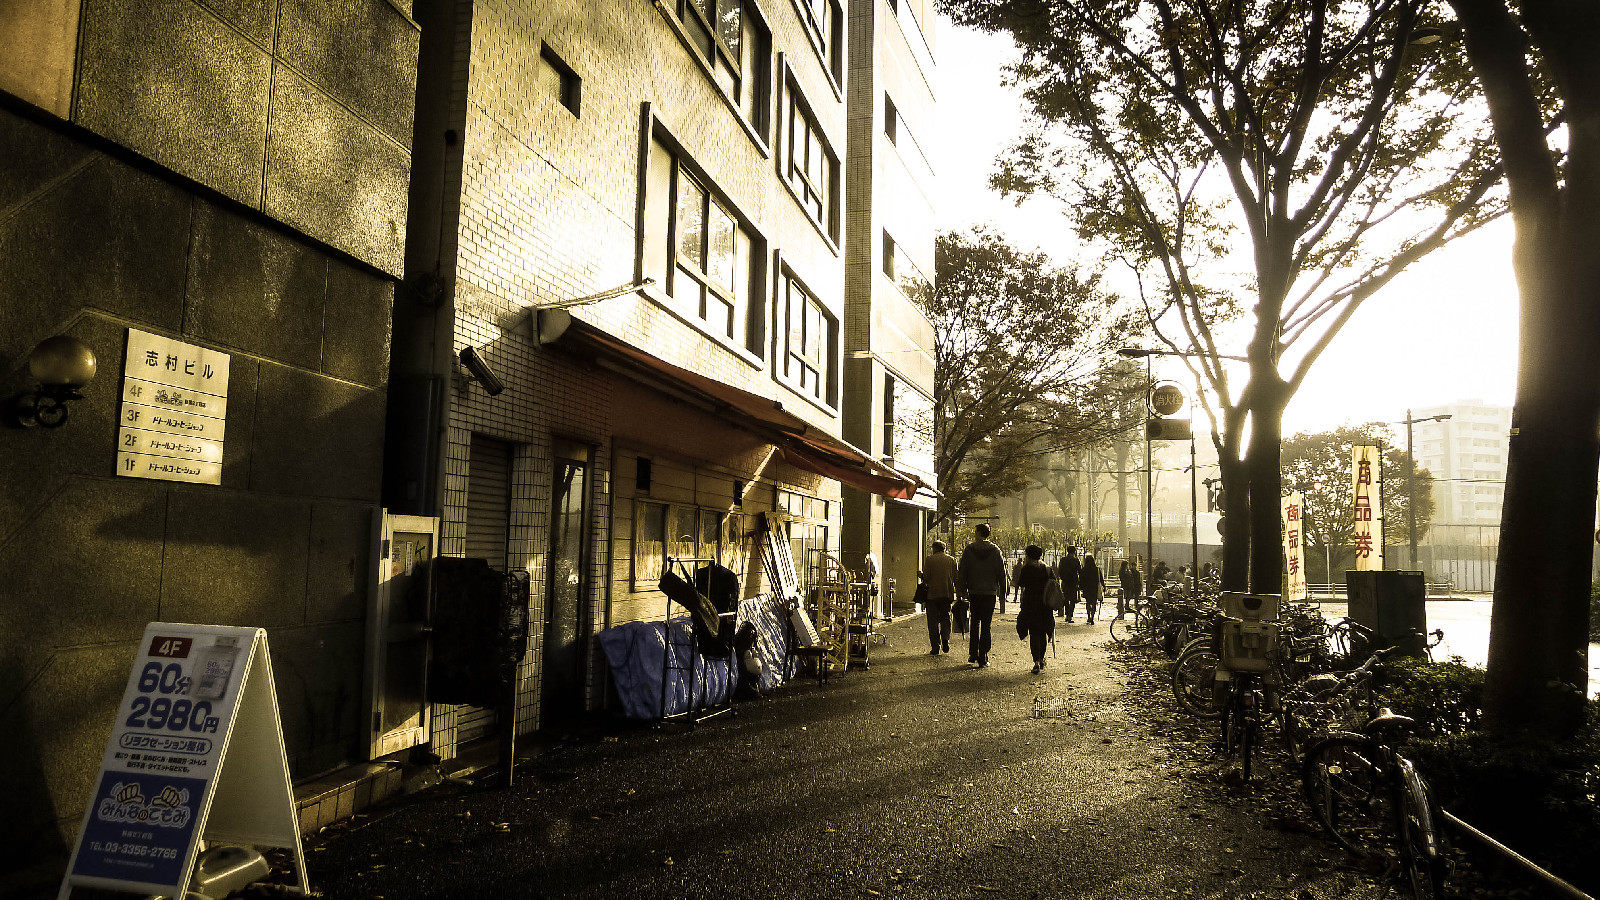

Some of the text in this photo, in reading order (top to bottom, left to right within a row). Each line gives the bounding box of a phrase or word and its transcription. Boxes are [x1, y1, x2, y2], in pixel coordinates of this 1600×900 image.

[145, 350, 214, 380] 志村ビル
[129, 384, 143, 398] 4F
[127, 409, 141, 422] 3F
[124, 434, 138, 447] 2F
[124, 458, 136, 471] 1F
[1354, 458, 1374, 559] 商品券
[1285, 504, 1300, 576] 商品券
[158, 640, 183, 656] 4F
[138, 661, 192, 695] 60分
[126, 696, 220, 733] 2980円
